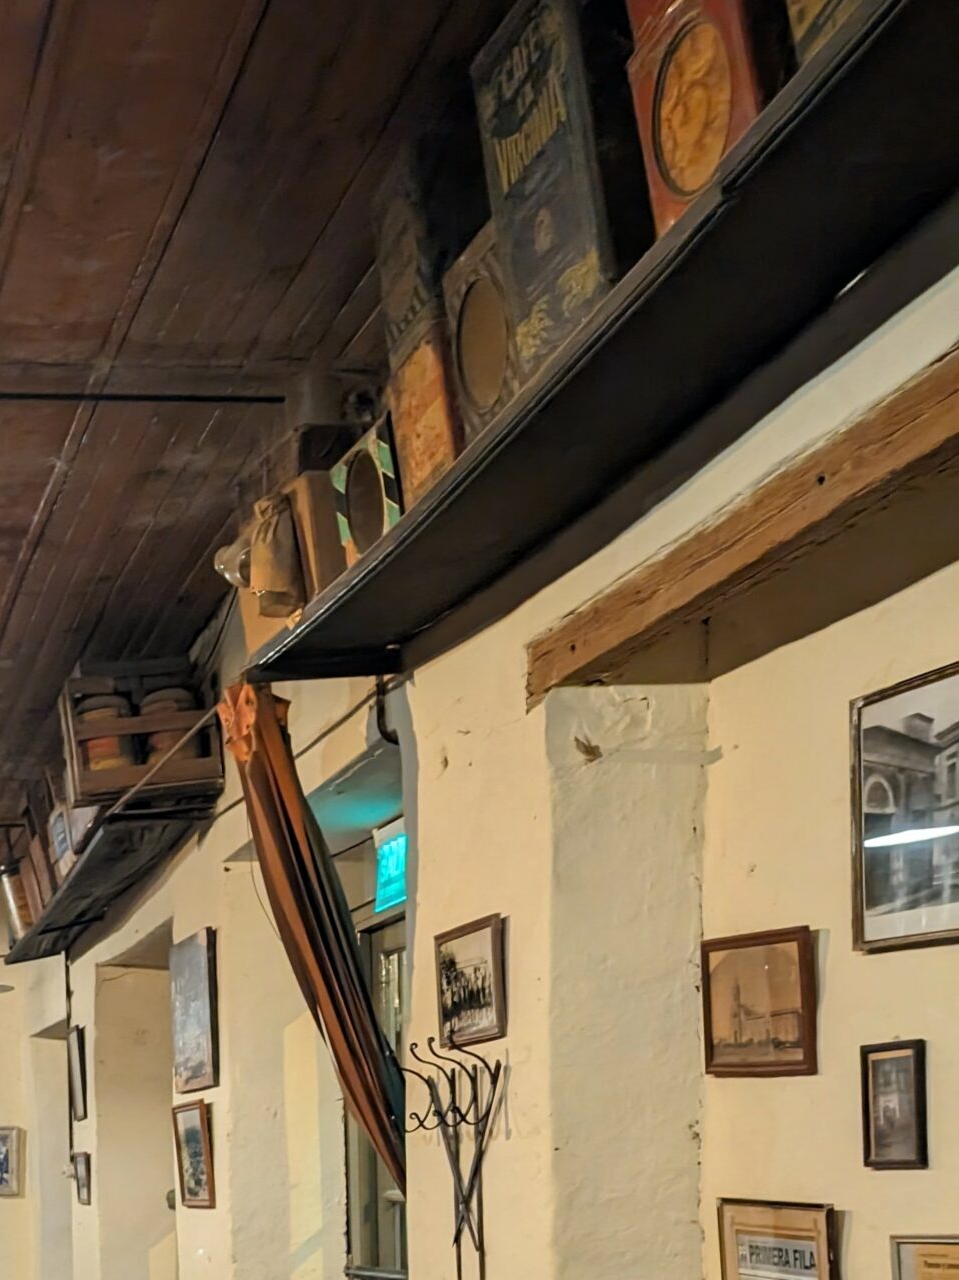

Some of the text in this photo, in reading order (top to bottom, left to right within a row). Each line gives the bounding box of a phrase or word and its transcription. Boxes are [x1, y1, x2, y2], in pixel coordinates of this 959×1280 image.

[494, 71, 567, 194] VIRGINIA
[748, 1245, 791, 1268] PRIMERA
[793, 1248, 817, 1270] FILA
